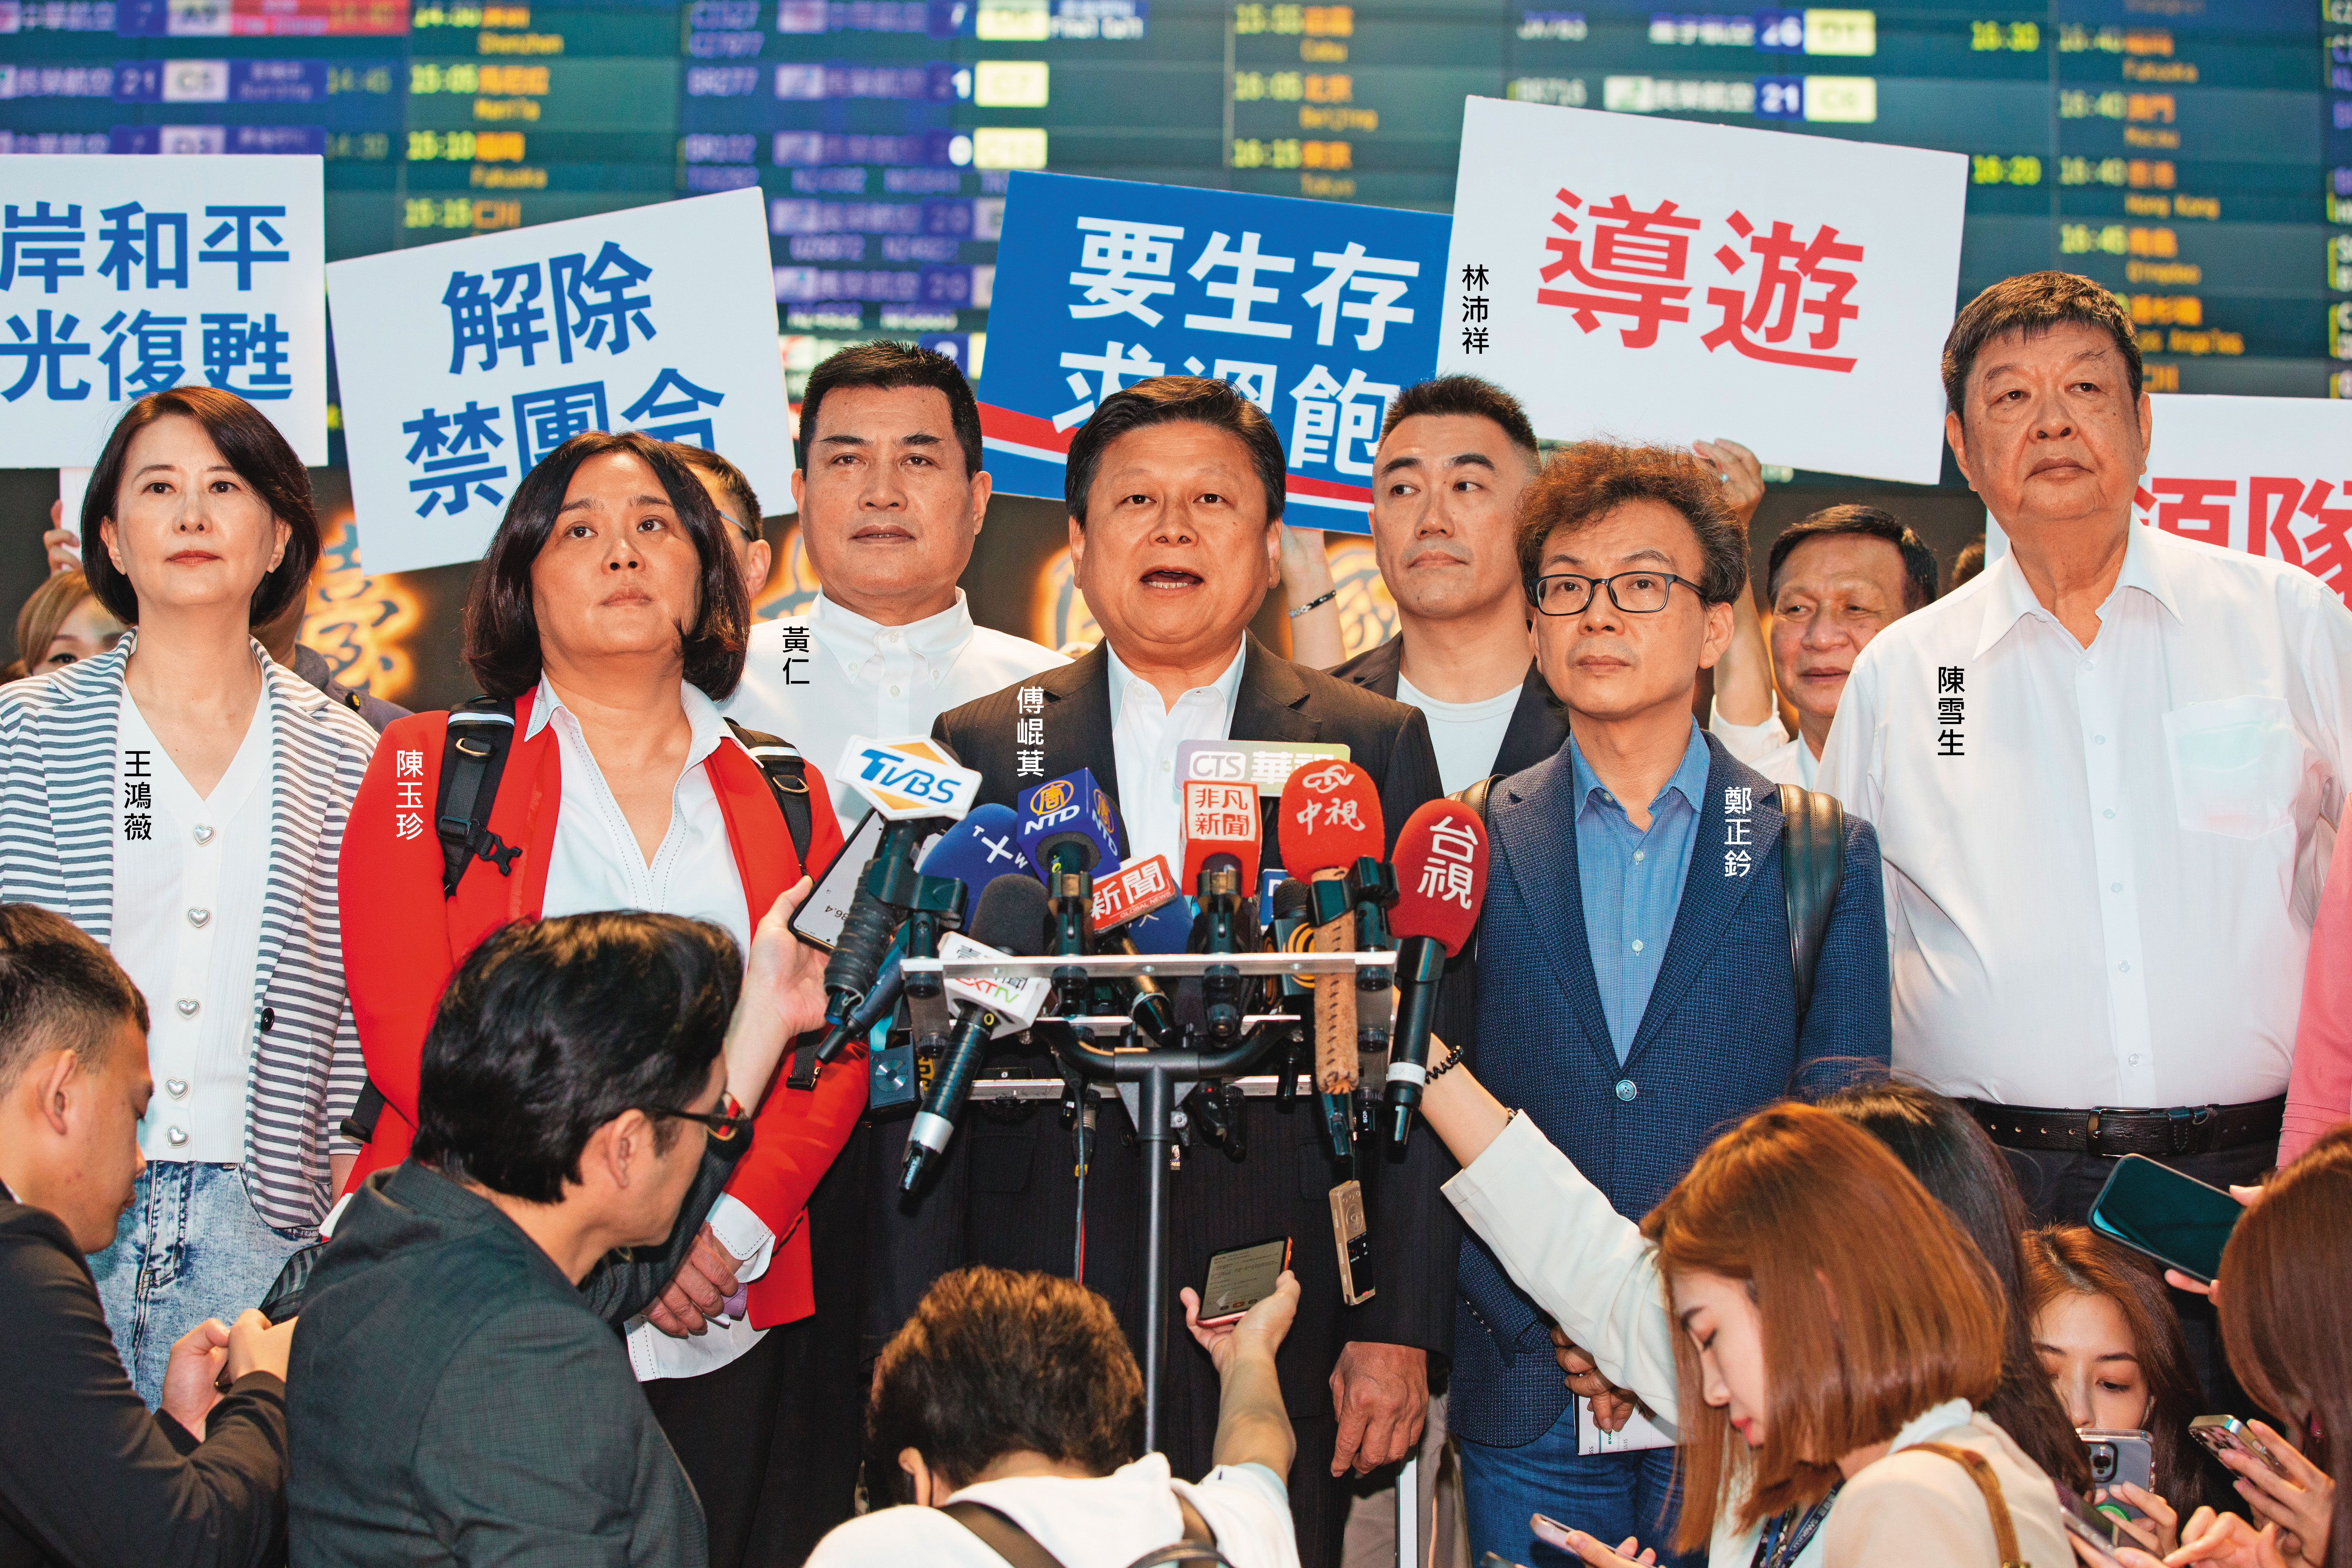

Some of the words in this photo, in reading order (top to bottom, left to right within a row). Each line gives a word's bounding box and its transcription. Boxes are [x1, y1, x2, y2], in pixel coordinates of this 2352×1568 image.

[1971, 20, 2040, 52] 16:30
[121, 69, 156, 95] 21
[1761, 83, 1800, 112] 21
[1298, 105, 1379, 132] Beijing
[0, 201, 290, 293] 岸和平
[1068, 216, 1420, 351] 要生存
[1537, 187, 1864, 373] 導遊
[441, 241, 656, 374] 解除
[0, 309, 293, 402] 光復甦
[860, 749, 961, 804] TVBS
[1193, 755, 1241, 777] CTS
[1195, 788, 1248, 811] 非凡
[1296, 797, 1366, 836] 中視
[1024, 805, 1080, 835] NTD
[1195, 813, 1250, 837] 新聞
[1417, 816, 1479, 910] 台視
[1091, 860, 1165, 921] 新聞
[1120, 902, 1147, 919] GLOBAL
[1149, 891, 1172, 905] NEWS
